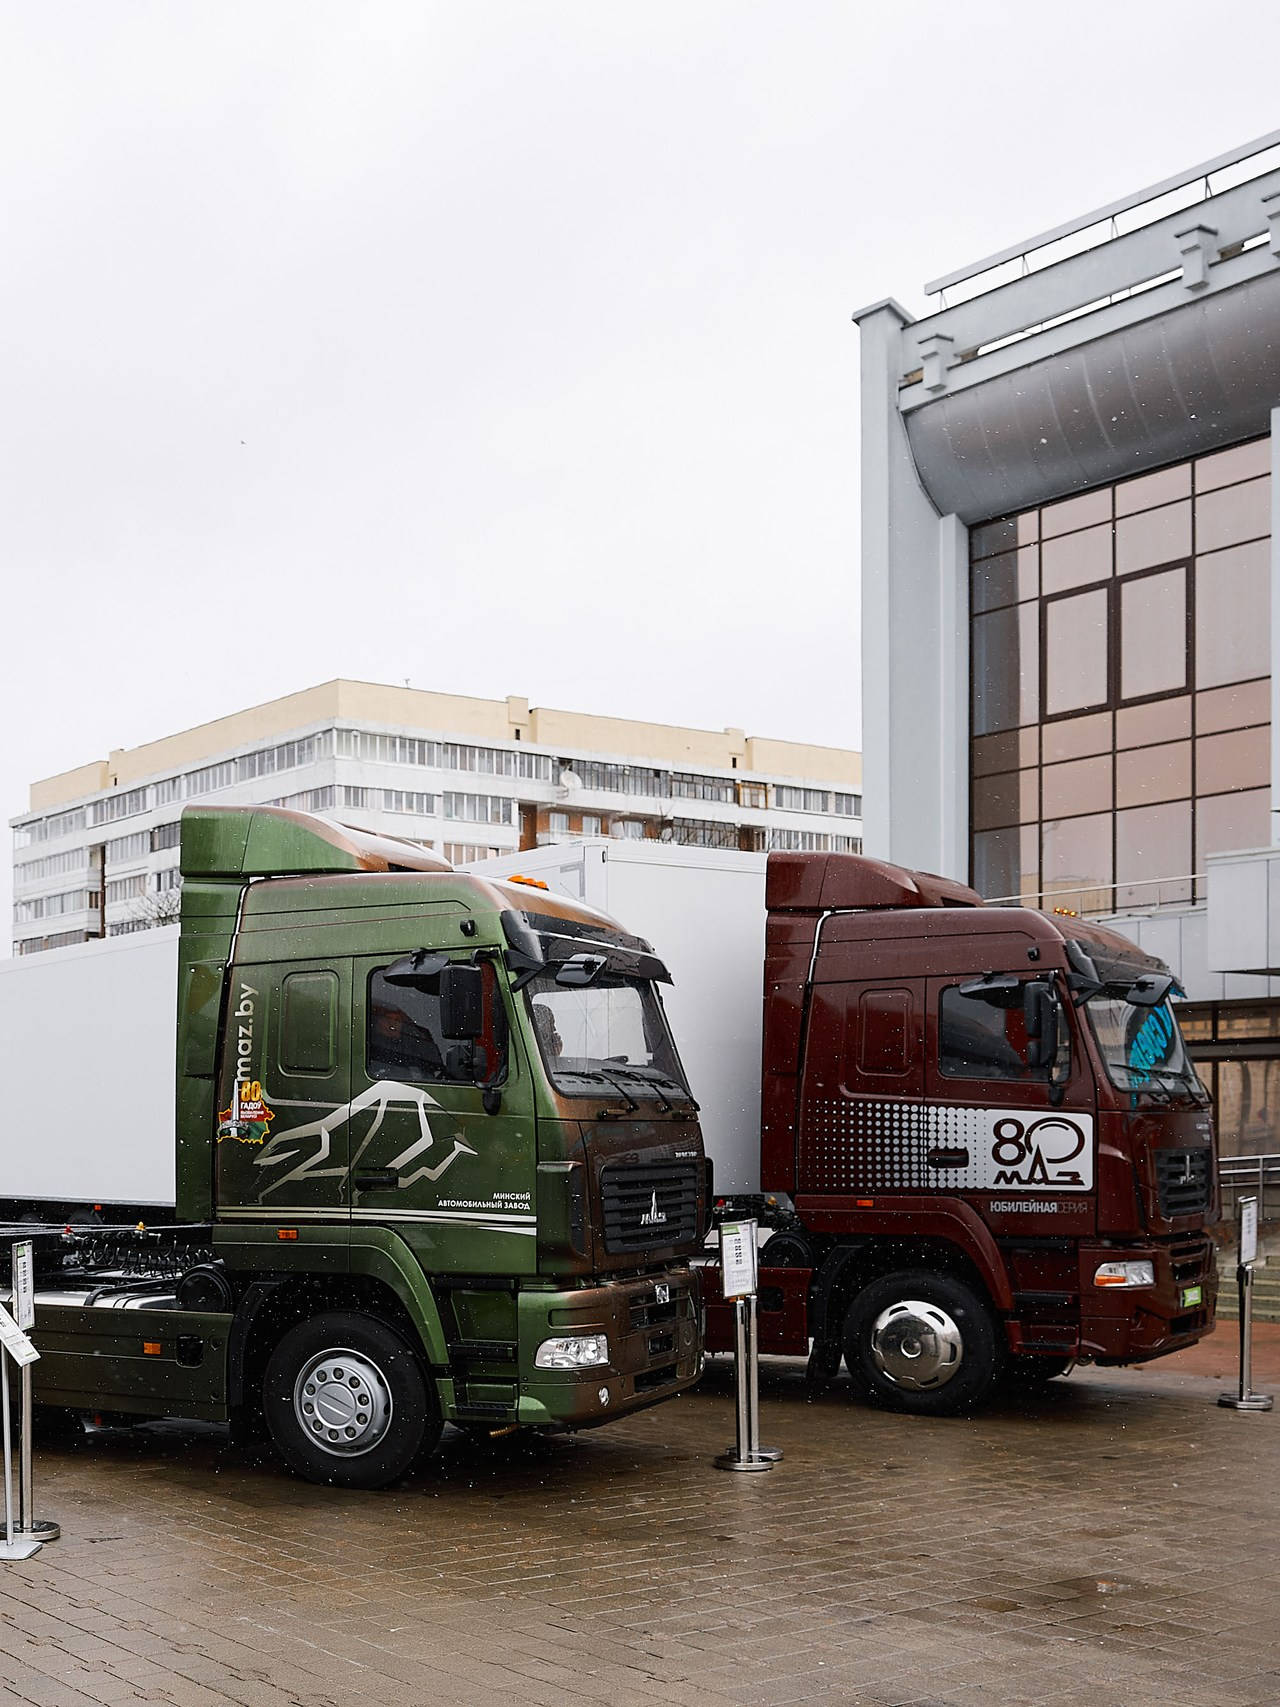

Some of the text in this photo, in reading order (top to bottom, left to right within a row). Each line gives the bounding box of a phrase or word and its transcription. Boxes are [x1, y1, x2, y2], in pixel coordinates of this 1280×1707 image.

[234, 983, 259, 1082] maz.by
[240, 1080, 262, 1102] 80
[492, 1192, 531, 1200] МИНСКИЙ
[437, 1199, 531, 1210] АВТОМОБИЛЬНЫЙ ЗАВОД
[990, 1200, 1058, 1213] ЮБИЛЕЙНАЯ
